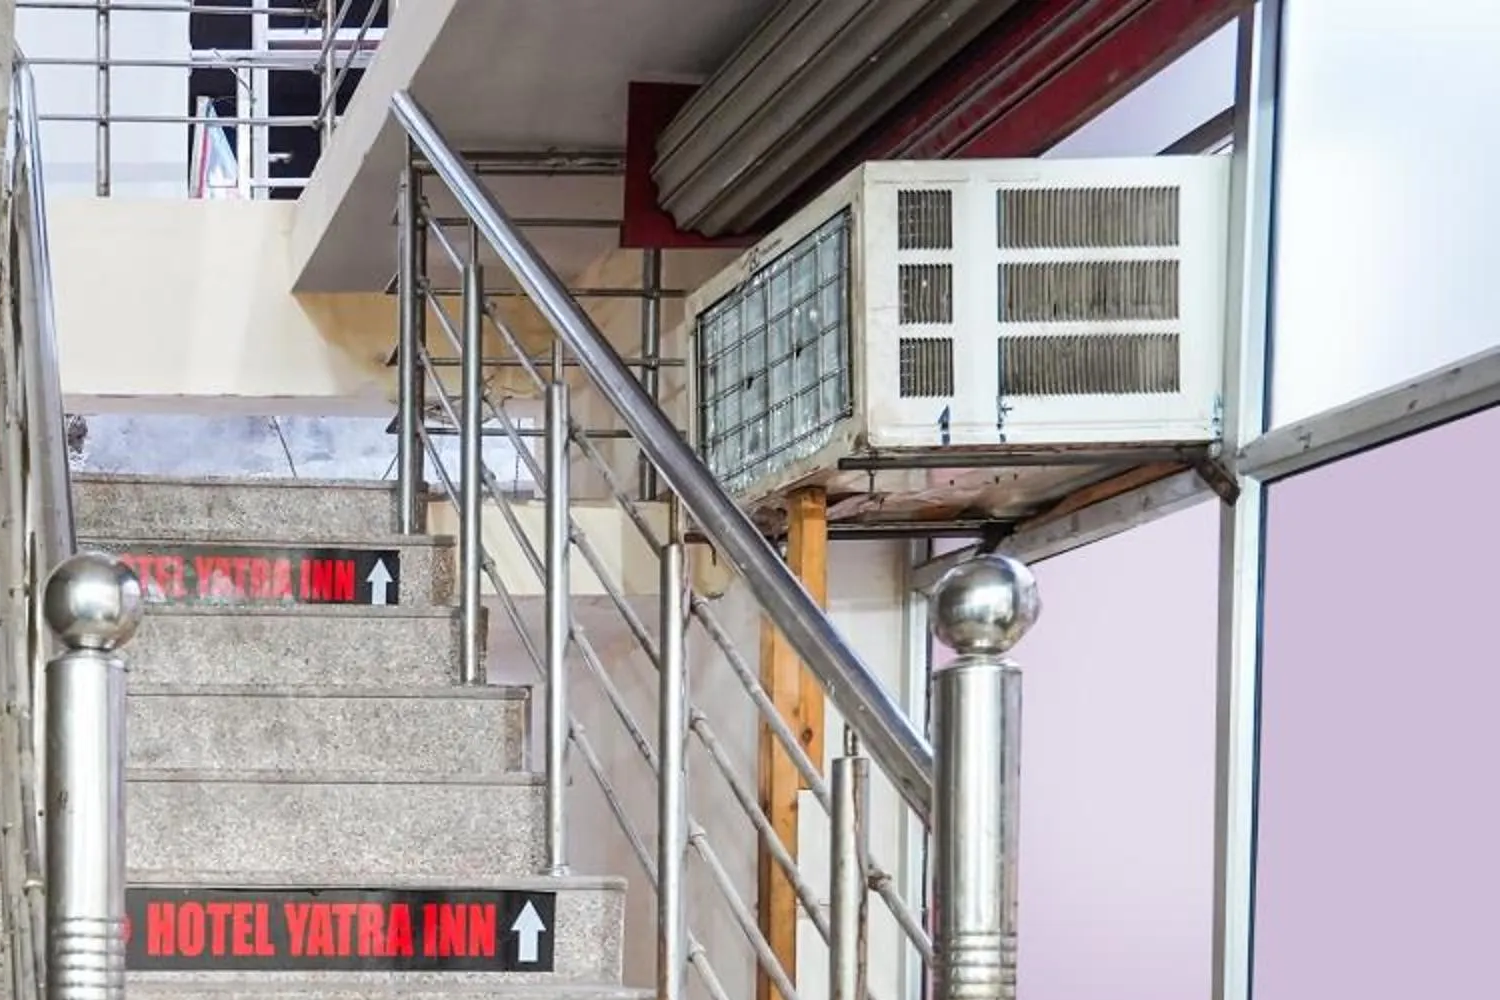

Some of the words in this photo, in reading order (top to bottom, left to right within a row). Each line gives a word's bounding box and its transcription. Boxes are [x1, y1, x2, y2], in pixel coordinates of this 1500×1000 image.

[195, 556, 293, 600] YATRA
[301, 559, 355, 600] INN
[147, 903, 274, 956] HOTEL
[284, 903, 414, 957] YATRA
[423, 904, 496, 957] INN
